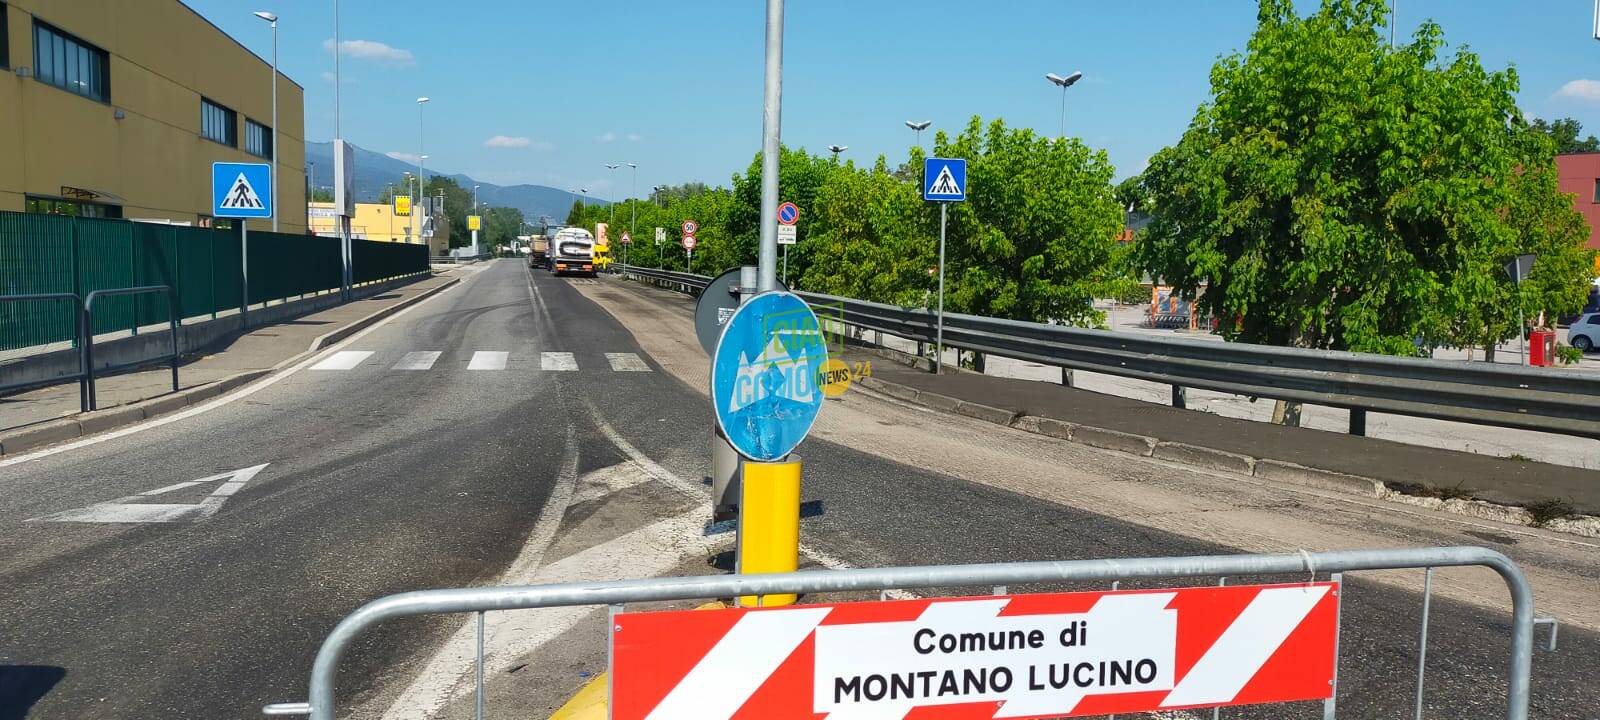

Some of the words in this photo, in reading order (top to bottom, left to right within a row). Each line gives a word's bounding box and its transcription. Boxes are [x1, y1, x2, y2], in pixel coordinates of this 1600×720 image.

[913, 628, 1045, 654] Comune
[1059, 620, 1087, 647] di
[834, 666, 1013, 703] MONTANO
[1029, 658, 1158, 691] LUCINO
